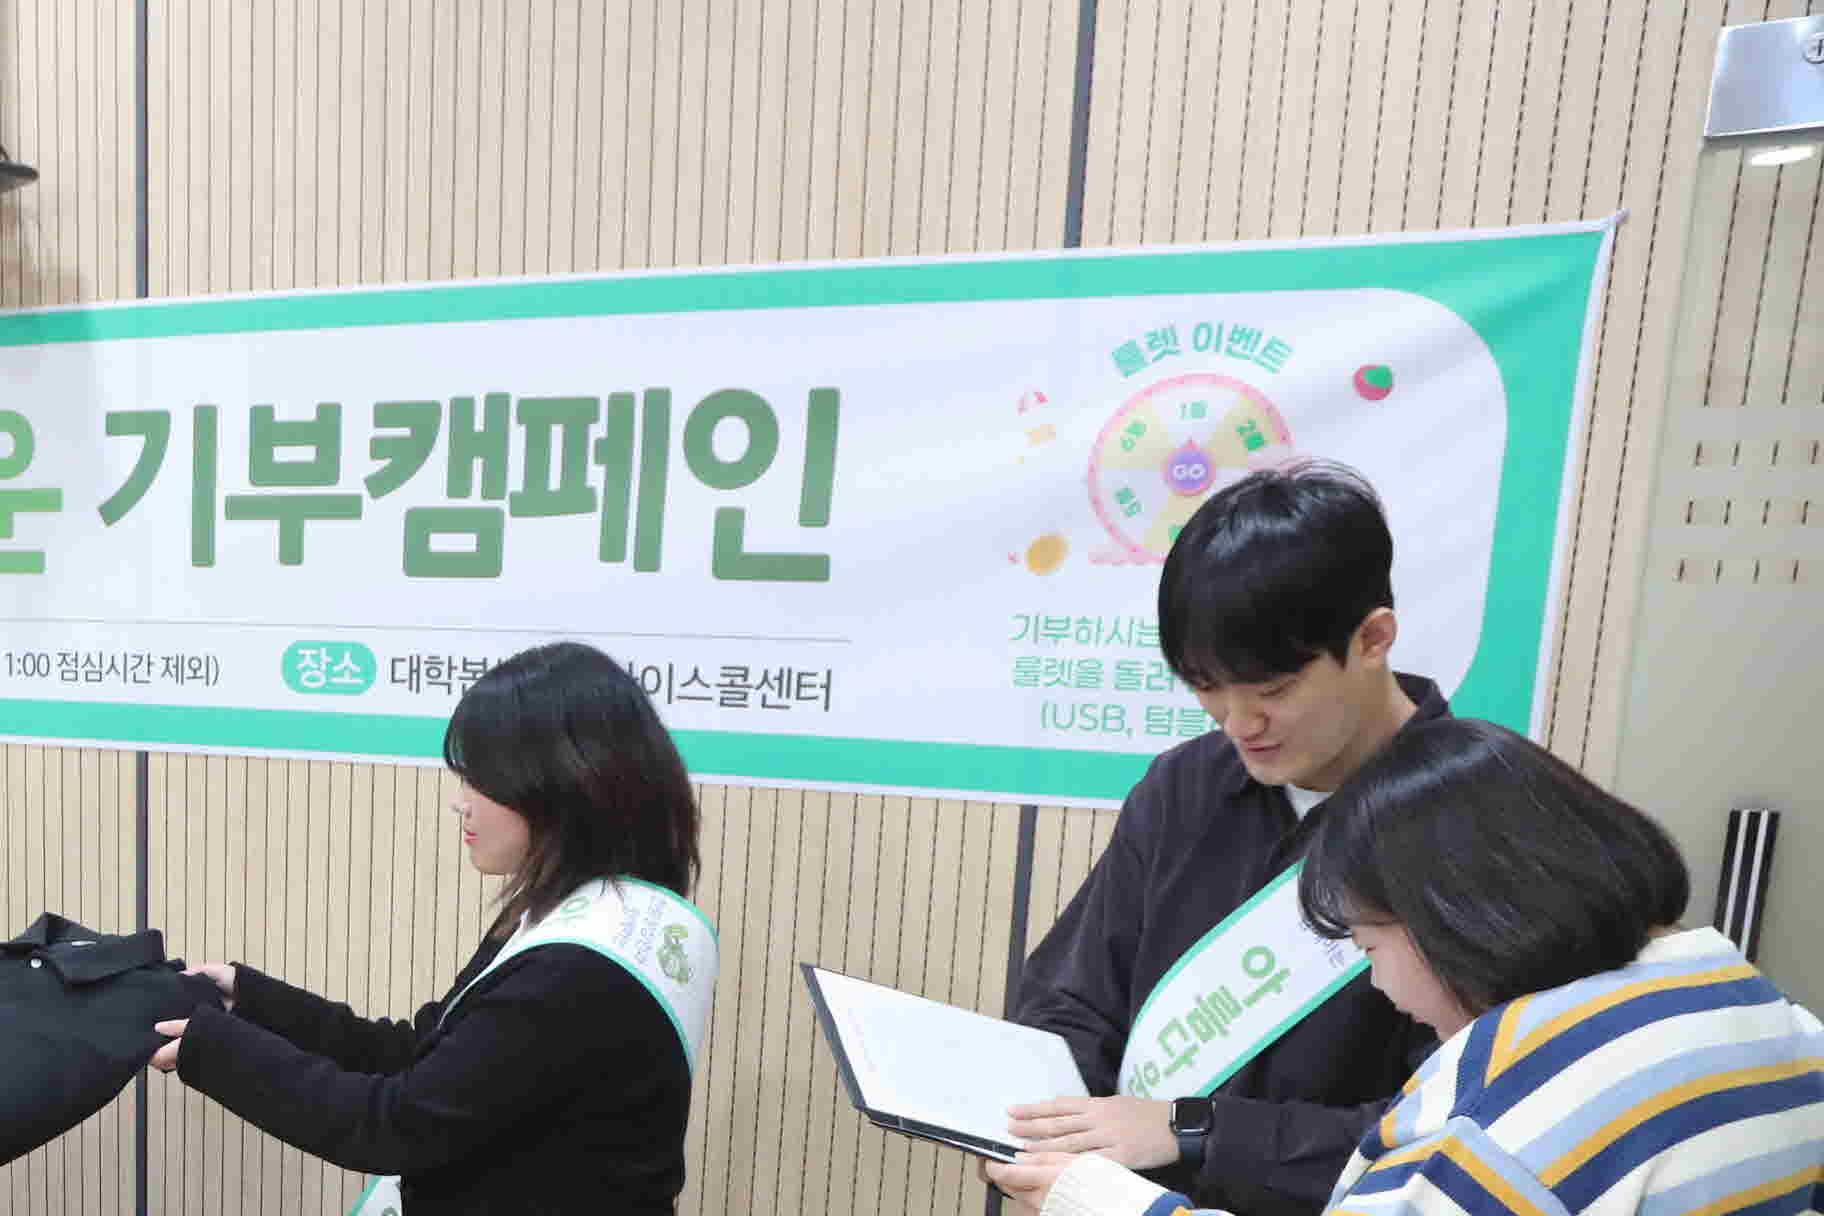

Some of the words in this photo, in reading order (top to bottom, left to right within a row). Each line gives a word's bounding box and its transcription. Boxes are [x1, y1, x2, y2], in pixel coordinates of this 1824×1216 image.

[1191, 321, 1292, 374] 이벤트
[96, 387, 841, 583] 기부캠페인
[1009, 612, 1161, 648] 기부하시는
[5, 652, 51, 678] 1:00
[56, 650, 156, 685] 점심시간
[160, 653, 221, 686] 제외)
[295, 648, 365, 689] 장소
[390, 654, 498, 697] 대학본
[1040, 700, 1135, 738] (USB,
[1144, 704, 1218, 737] 텀블
